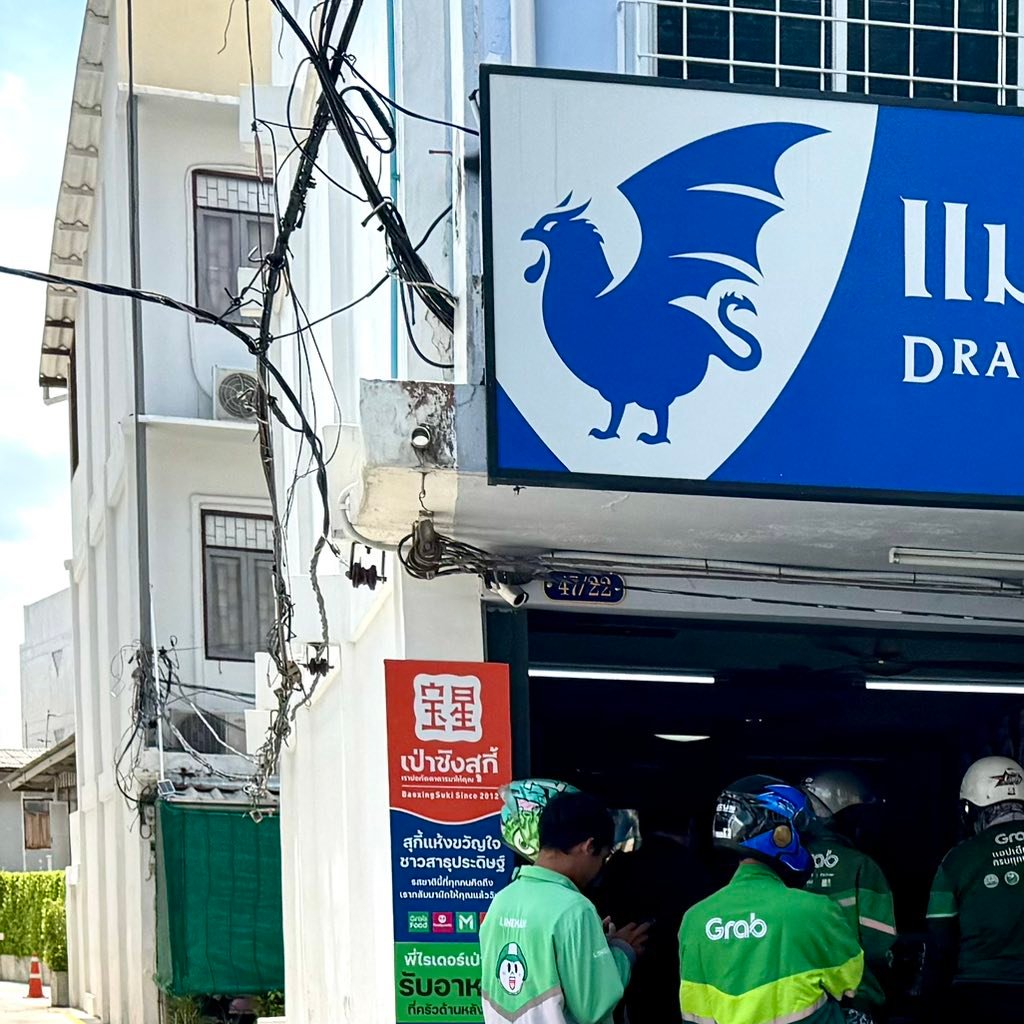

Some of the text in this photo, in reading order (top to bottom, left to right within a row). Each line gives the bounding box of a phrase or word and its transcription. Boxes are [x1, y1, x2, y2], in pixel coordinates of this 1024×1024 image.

[420, 682, 476, 732] 宝星
[479, 791, 499, 800] 2012
[705, 912, 768, 941] Grab
[399, 971, 482, 997] รับอาห
